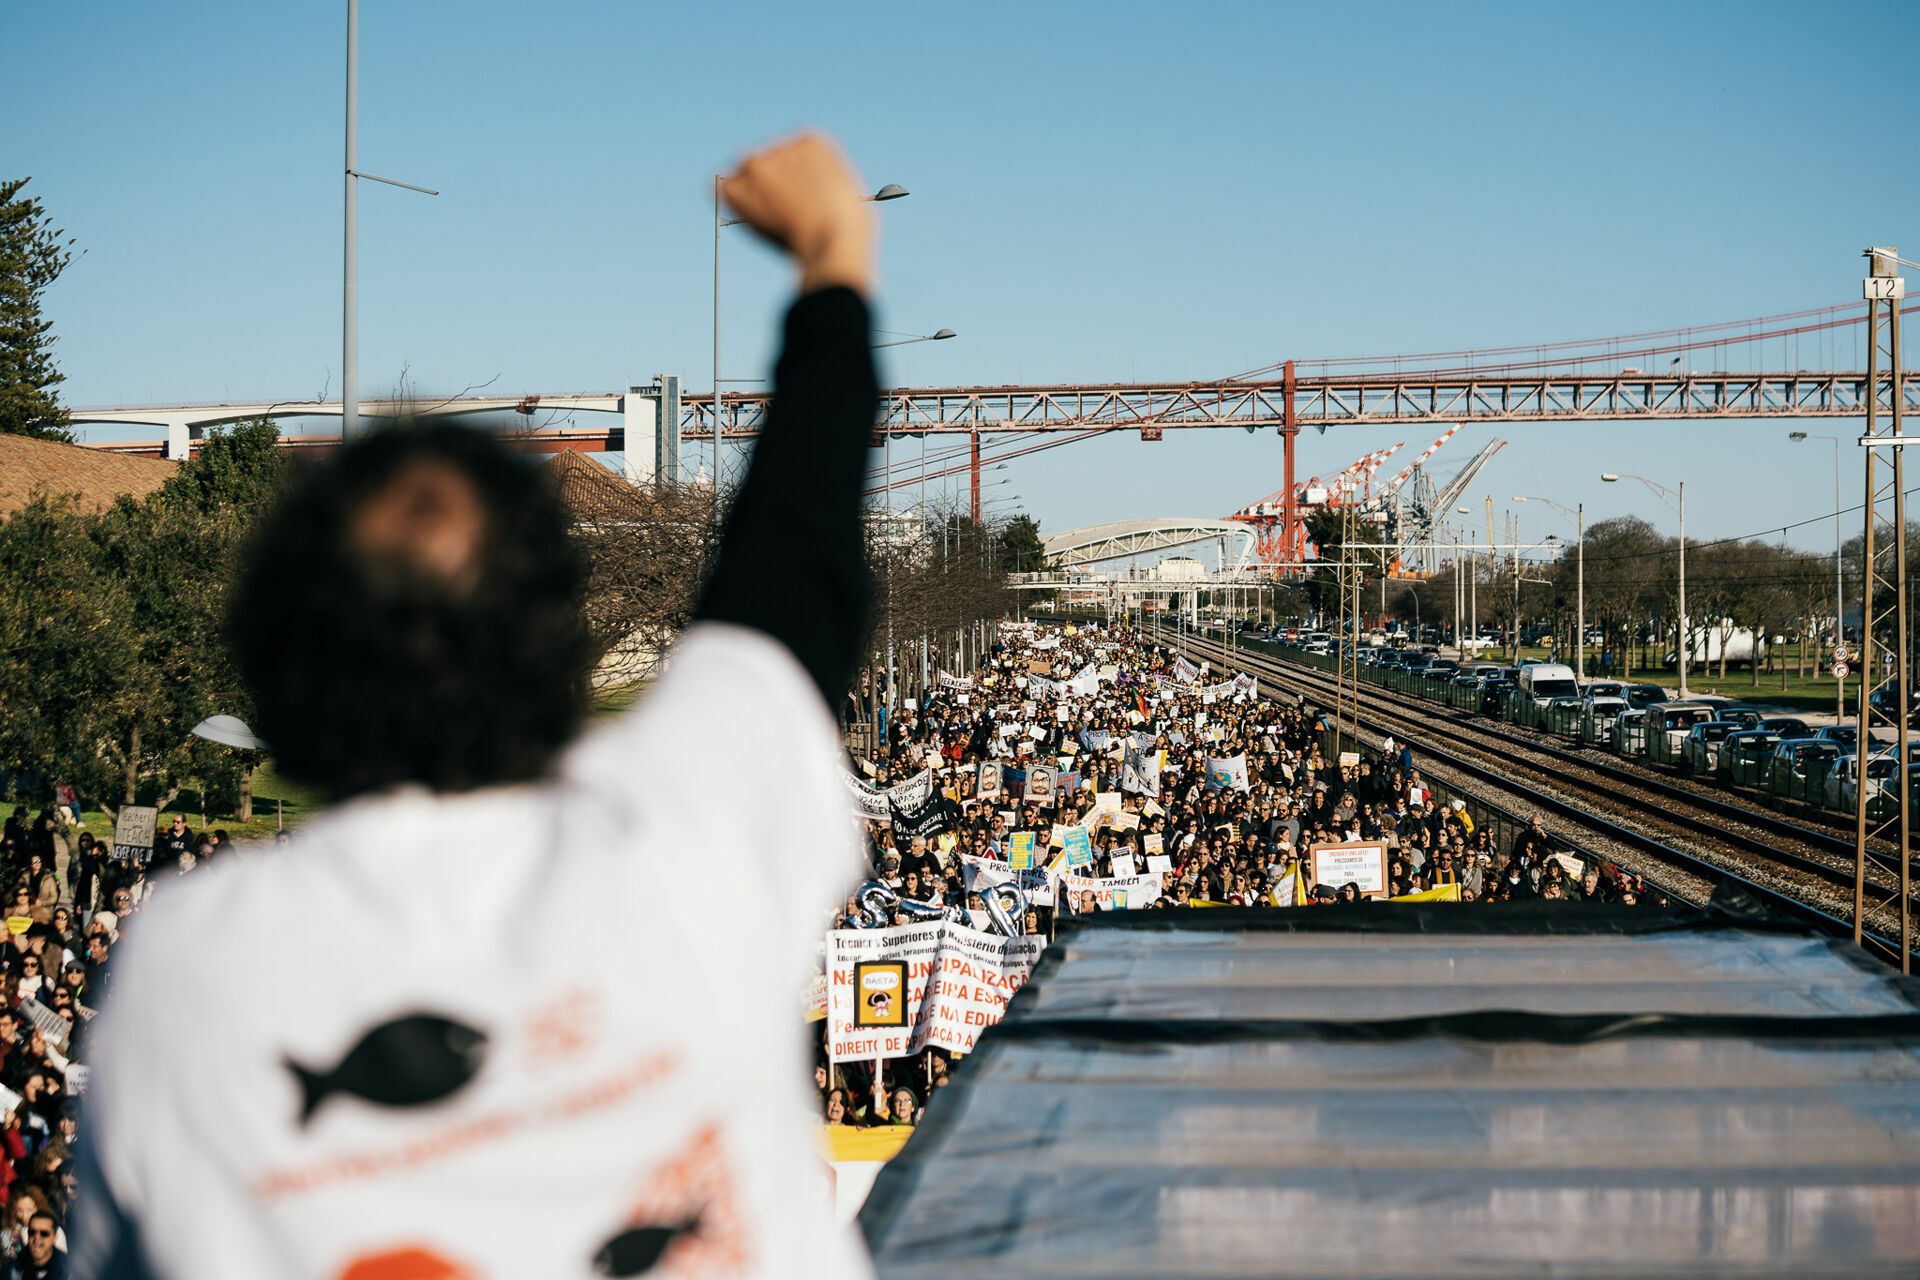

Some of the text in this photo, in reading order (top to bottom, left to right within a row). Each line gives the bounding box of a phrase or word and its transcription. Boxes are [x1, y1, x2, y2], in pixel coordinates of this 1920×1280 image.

[1872, 279, 1895, 298] 12
[122, 827, 151, 845] TEACH
[989, 862, 1049, 881] PROESORES
[882, 931, 935, 948] Superiores
[907, 957, 1029, 992] UNICIPALIZAÇÃ
[974, 987, 1009, 1011] ESPE
[965, 1010, 1003, 1026] EDU
[885, 1037, 900, 1051] DE
